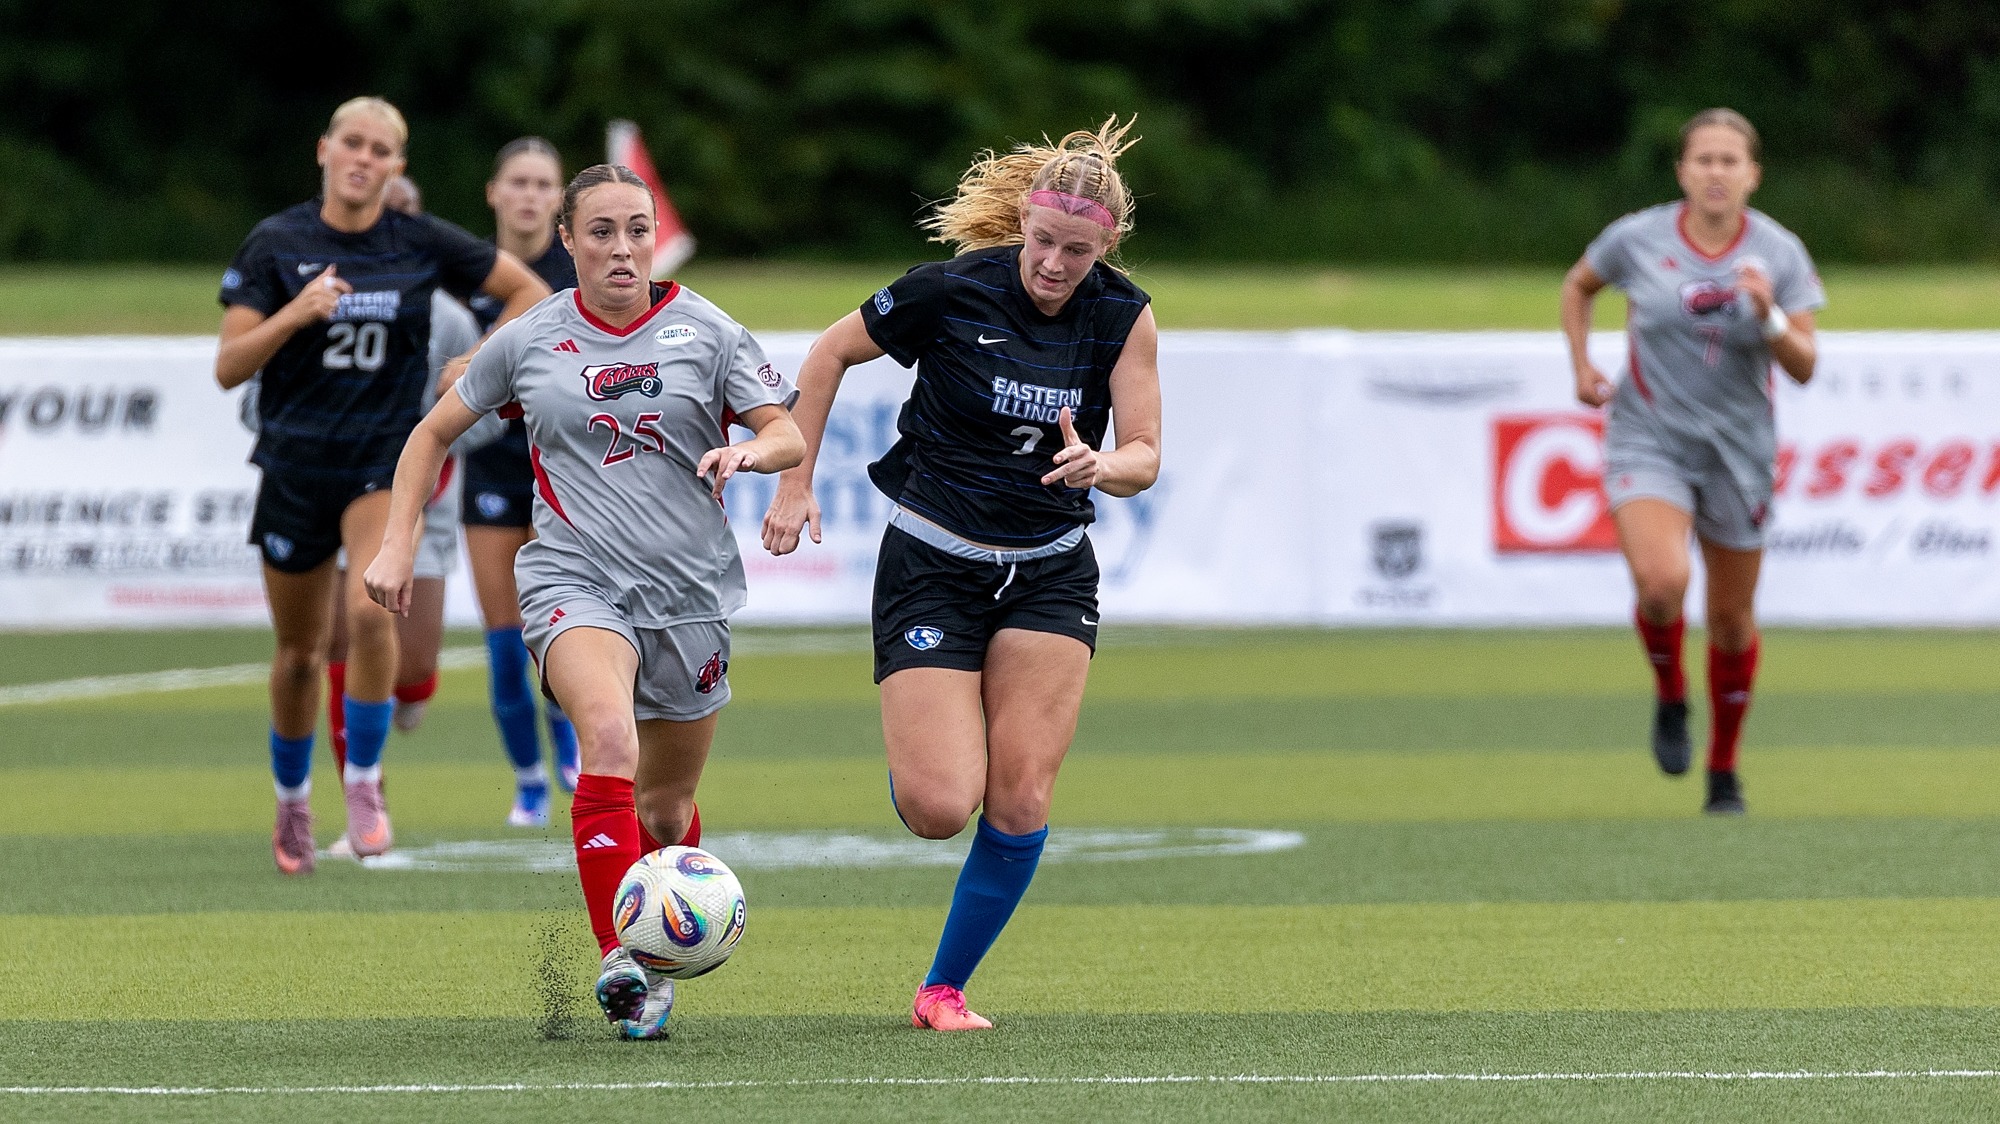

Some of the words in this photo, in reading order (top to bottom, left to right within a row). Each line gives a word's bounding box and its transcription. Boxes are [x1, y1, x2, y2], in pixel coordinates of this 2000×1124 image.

[323, 322, 388, 371] 20
[1692, 322, 1724, 366] 7
[992, 376, 1082, 407] EASTERN
[992, 395, 1079, 425] ILLINOS
[587, 410, 666, 468] 25
